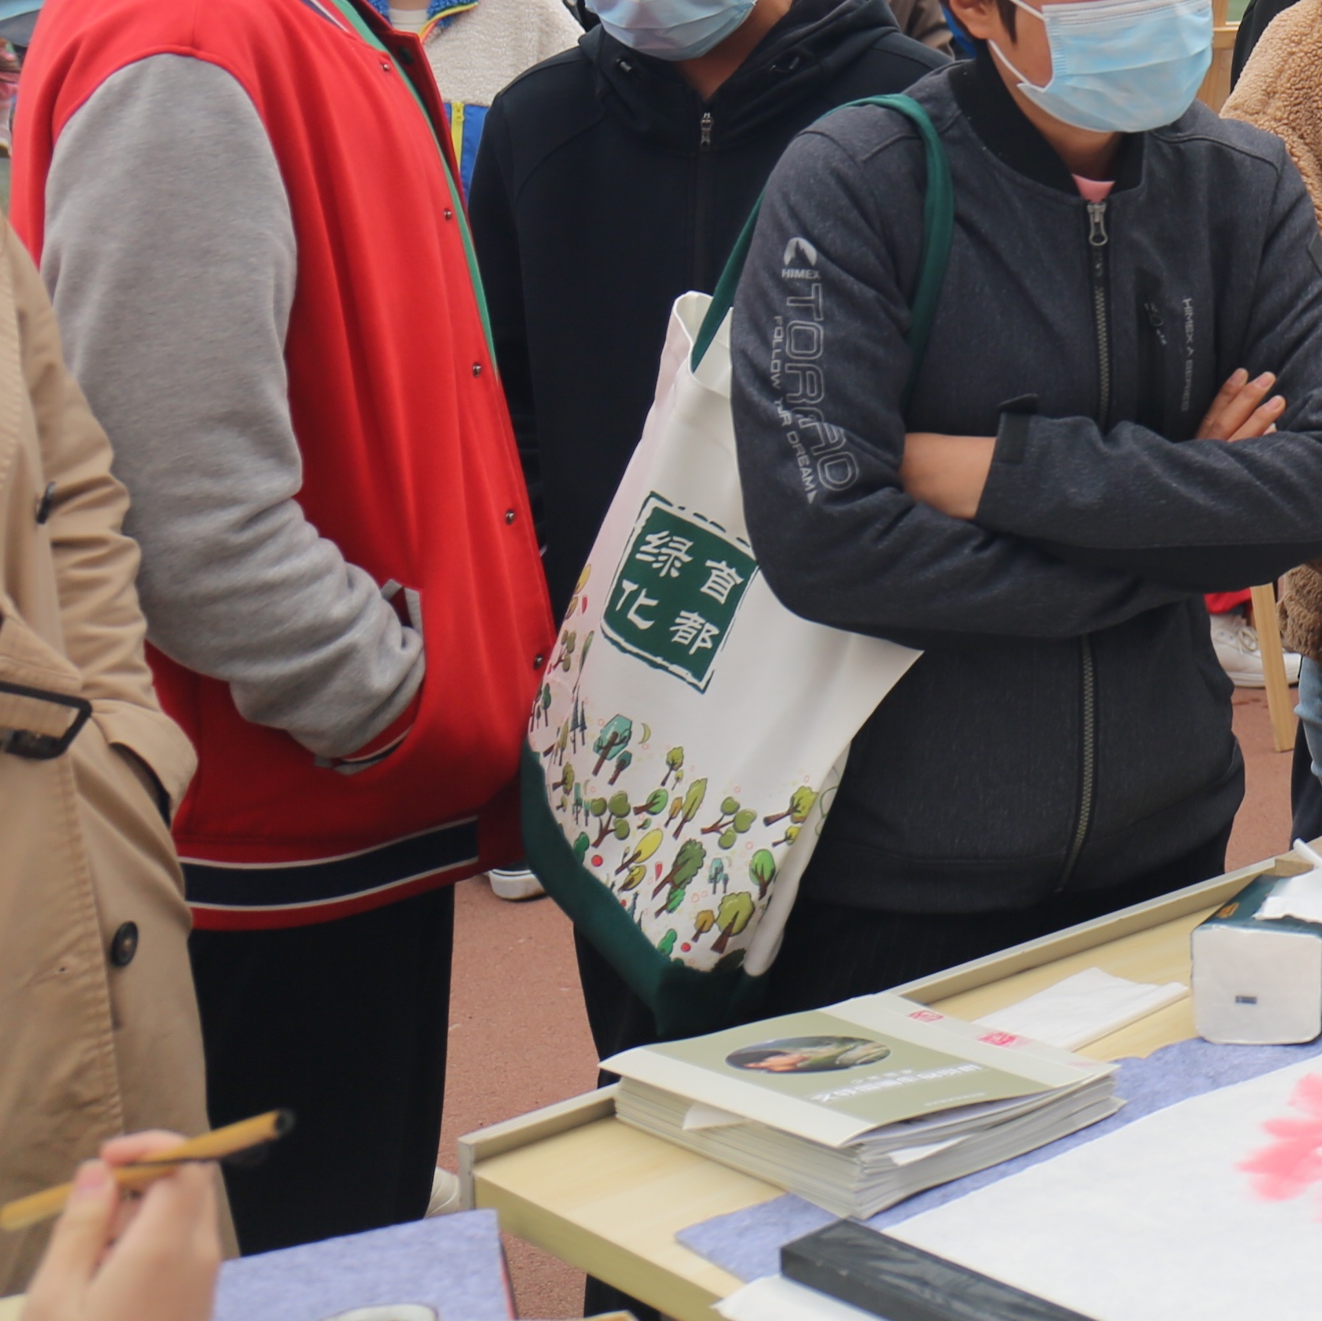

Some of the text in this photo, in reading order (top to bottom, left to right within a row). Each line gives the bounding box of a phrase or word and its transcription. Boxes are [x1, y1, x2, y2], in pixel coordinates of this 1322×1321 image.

[781, 268, 821, 280] HIMEX
[1182, 297, 1195, 344] HIMEX
[770, 315, 785, 389] FOLLOW
[786, 430, 816, 491] DREAM
